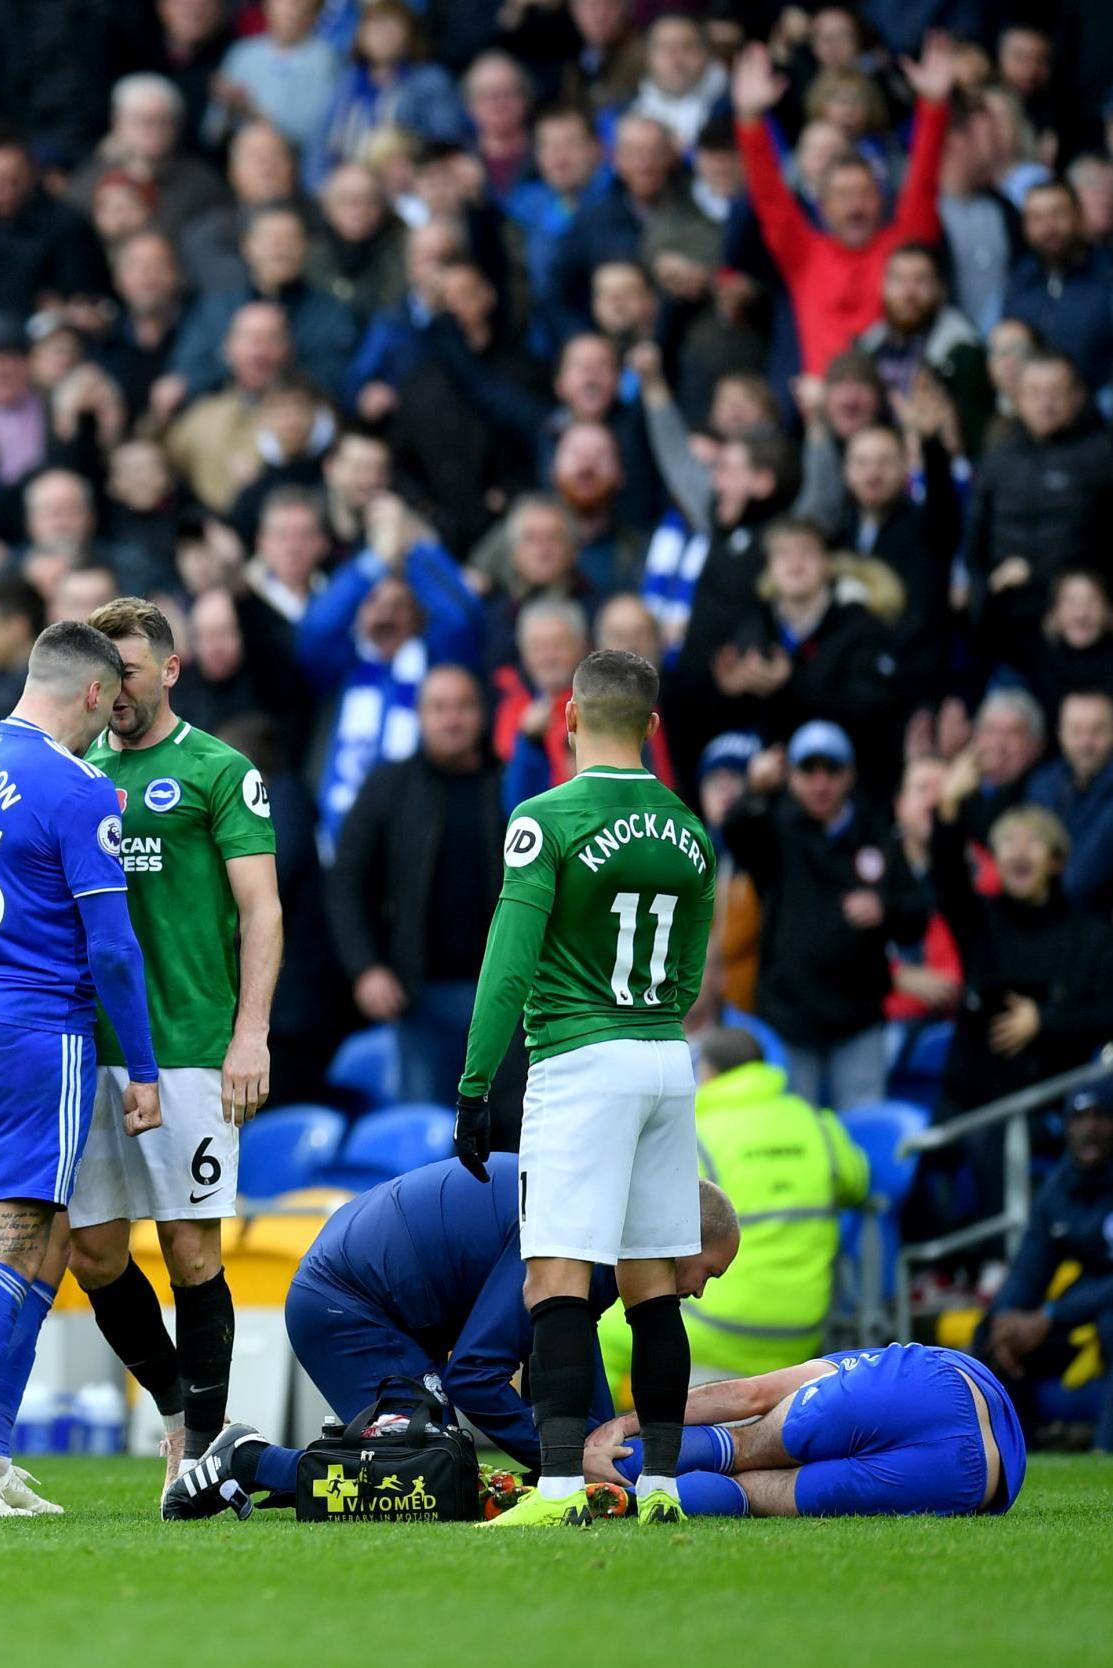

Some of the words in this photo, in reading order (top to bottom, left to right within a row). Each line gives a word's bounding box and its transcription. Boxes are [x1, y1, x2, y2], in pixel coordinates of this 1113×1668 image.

[578, 812, 707, 875] KNOCKAERT
[610, 892, 679, 1006] 11
[191, 1136, 222, 1186] 6
[346, 1494, 437, 1512] VIVOMED
